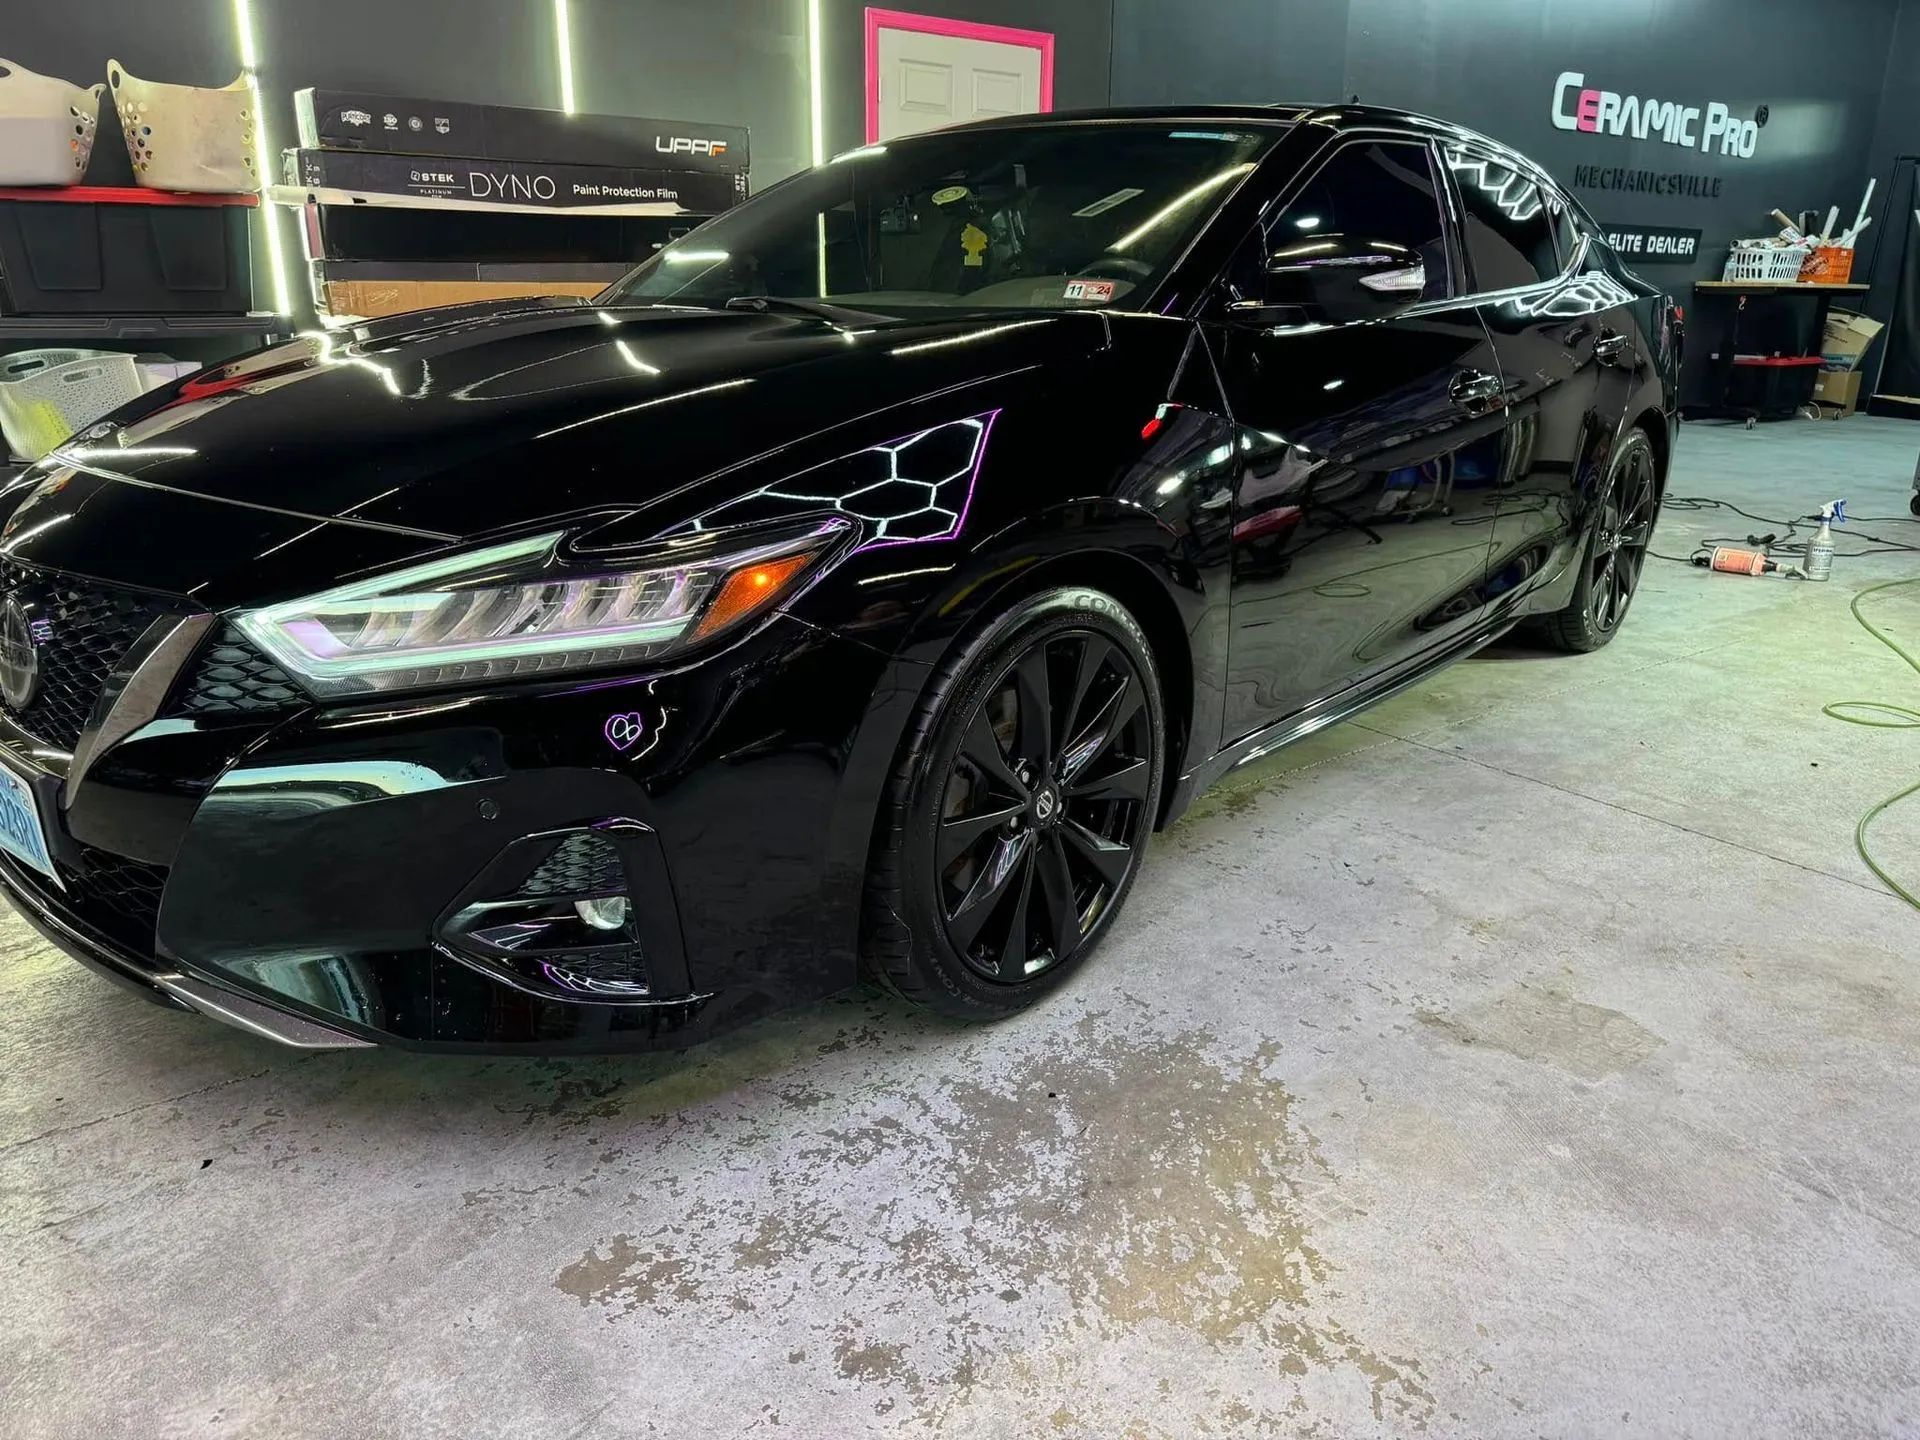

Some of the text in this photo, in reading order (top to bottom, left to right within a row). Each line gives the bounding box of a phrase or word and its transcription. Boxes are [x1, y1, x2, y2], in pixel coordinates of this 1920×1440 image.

[655, 135, 727, 156] UPPF
[421, 172, 455, 183] STEK
[469, 171, 556, 200] DYNO
[1574, 165, 1722, 197] MECHANICSVILLE
[572, 184, 678, 199] Paint Protection Film
[1608, 233, 1696, 255] ELITE DEALER
[1069, 285, 1111, 296] 11 24
